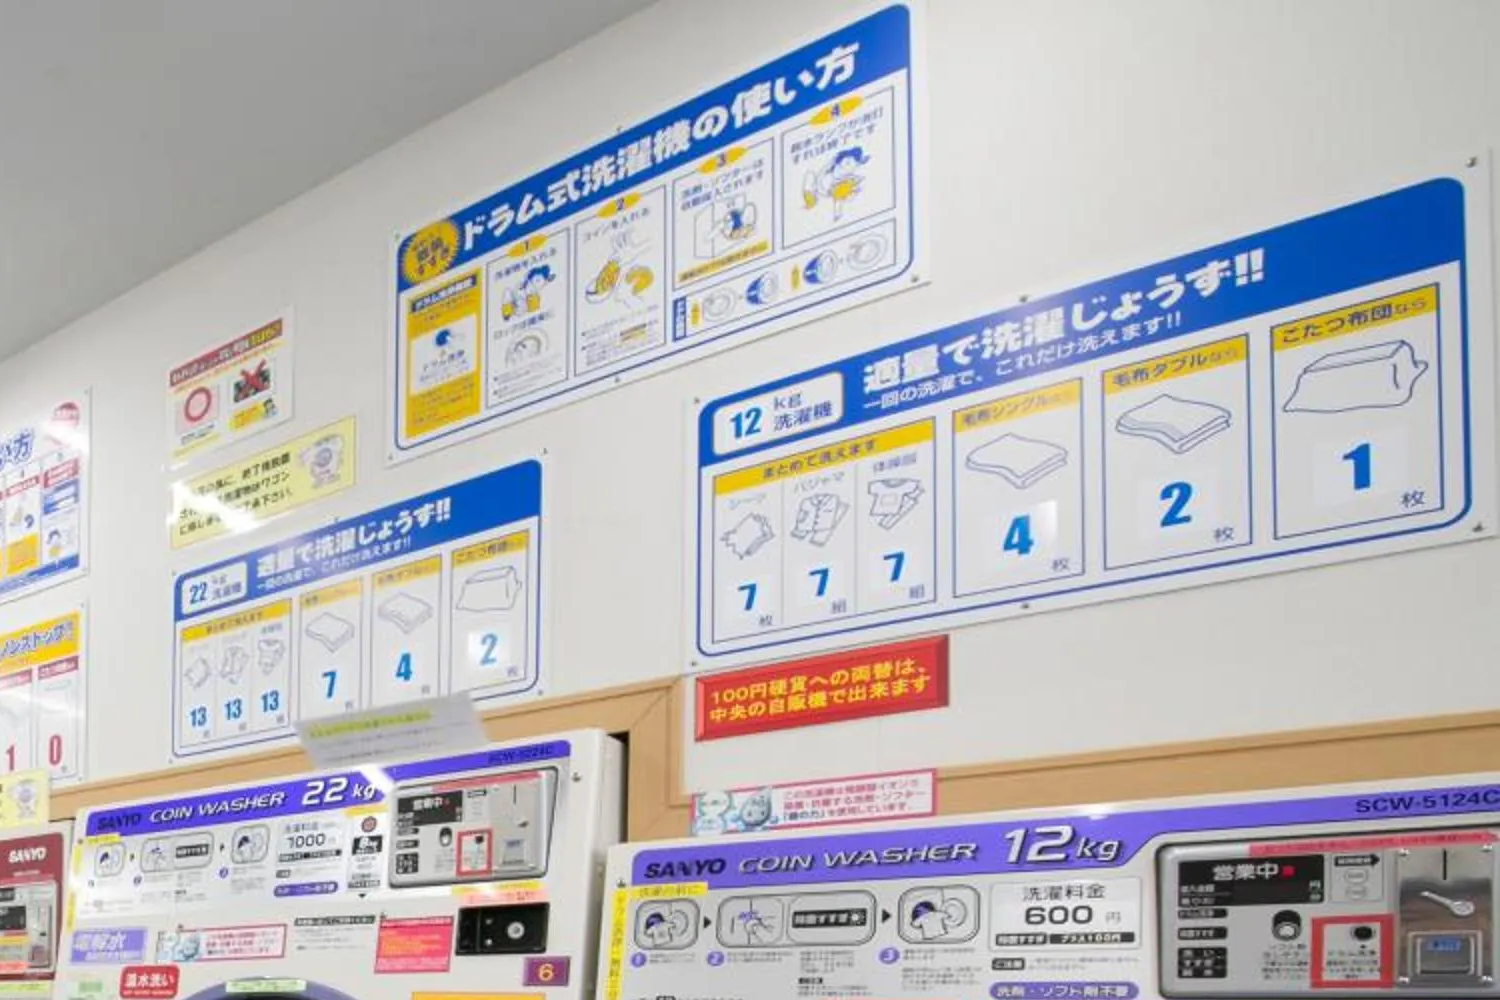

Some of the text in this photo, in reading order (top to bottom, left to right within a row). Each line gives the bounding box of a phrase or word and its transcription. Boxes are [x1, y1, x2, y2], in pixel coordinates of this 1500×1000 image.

[463, 42, 860, 251] ドラム式洗濯機の使い方
[730, 407, 763, 440] 12
[773, 403, 833, 433] 洗濯機
[1342, 442, 1426, 508] 1 枚
[1159, 480, 1235, 543] 2 枚
[1002, 514, 1035, 556] 4
[809, 567, 831, 597] 7
[883, 551, 906, 583] 7
[189, 582, 208, 605] 22
[737, 582, 757, 612] 7
[479, 633, 500, 666] 2
[395, 652, 413, 681] 4
[711, 657, 928, 706] 100円硬貨への両替は、
[320, 670, 338, 699] 7
[708, 674, 931, 723] 中央の自販機で出来ます
[224, 698, 242, 721] 13
[260, 690, 281, 712] 13
[190, 706, 208, 727] 13
[5, 744, 16, 772] 1
[48, 734, 62, 766] 0
[96, 779, 378, 831] SANYO COIN WASHER 22 kg
[8, 847, 47, 864] SANYO
[643, 824, 1122, 880] SANYO COIN WASHER 12 kg
[1213, 861, 1280, 883] 営業中
[1023, 883, 1106, 900] 洗濯料金
[1025, 905, 1094, 925] 600
[126, 971, 175, 988] 温水洗い
[537, 962, 555, 982] 6
